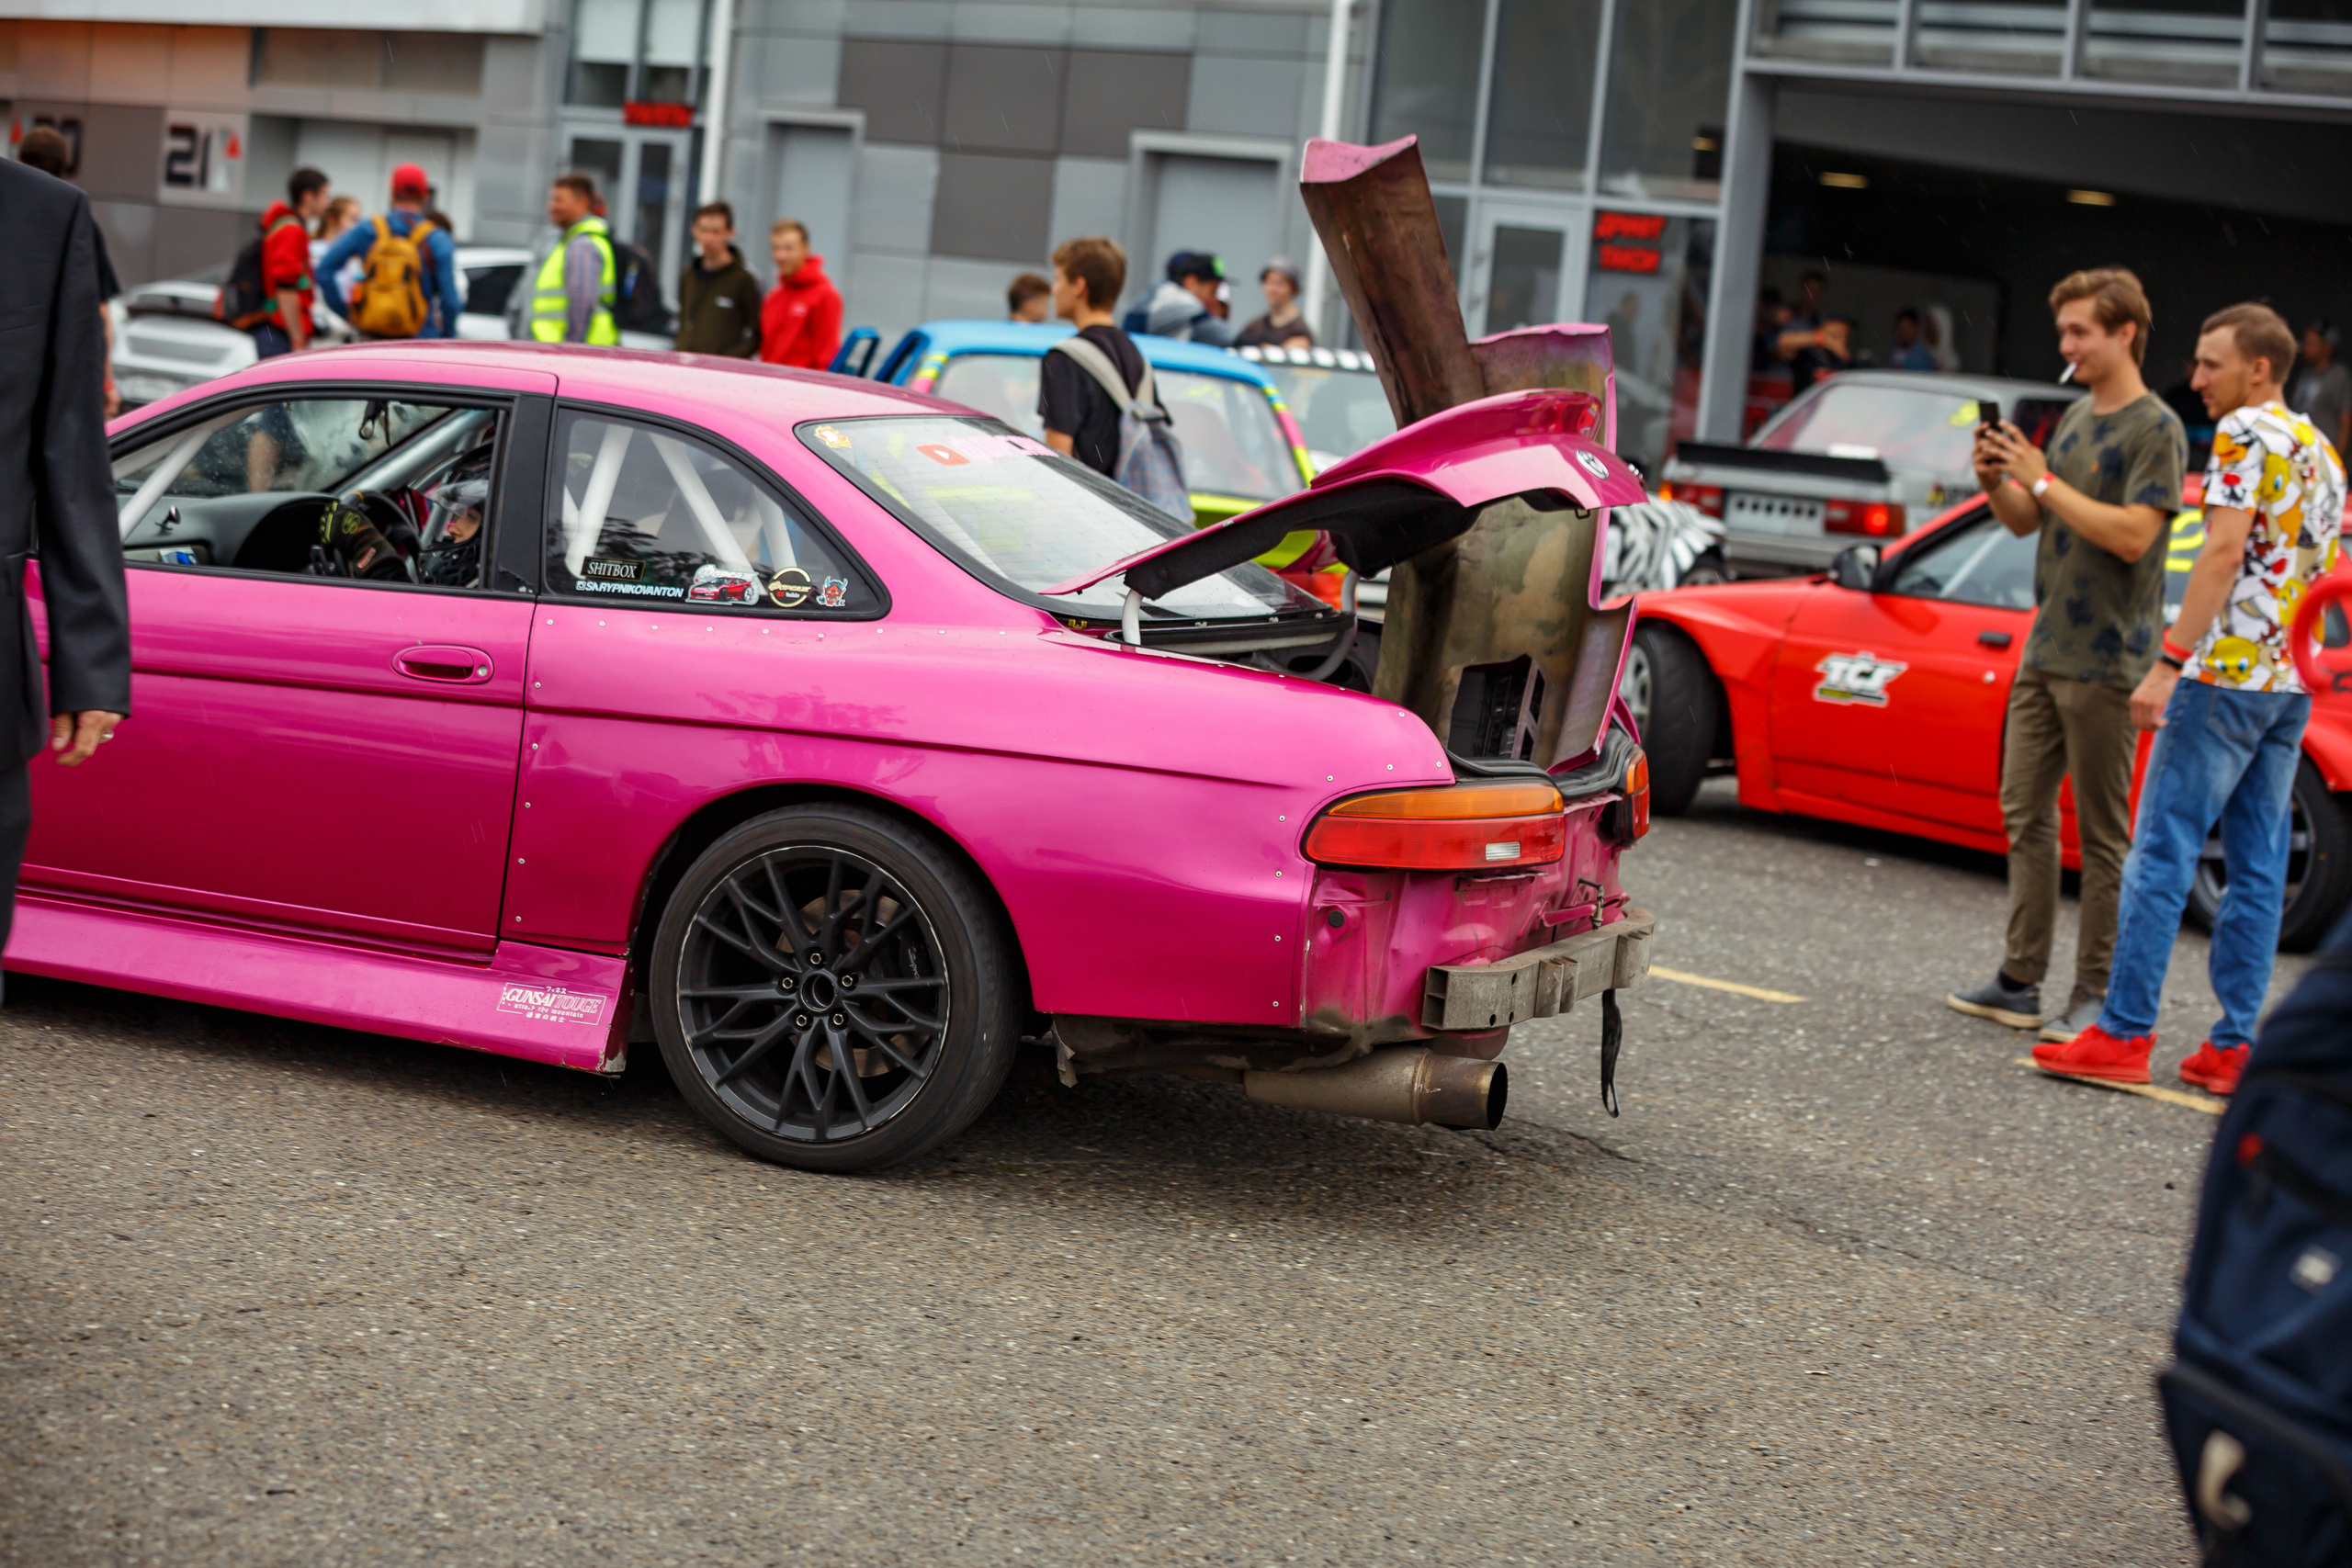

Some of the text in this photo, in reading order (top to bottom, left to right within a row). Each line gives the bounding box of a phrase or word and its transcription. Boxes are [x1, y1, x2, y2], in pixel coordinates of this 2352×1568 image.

[165, 123, 212, 189] 21
[587, 561, 638, 579] SHITBOX
[506, 988, 557, 1006] GUNSAI
[555, 996, 602, 1013] TOUGE
